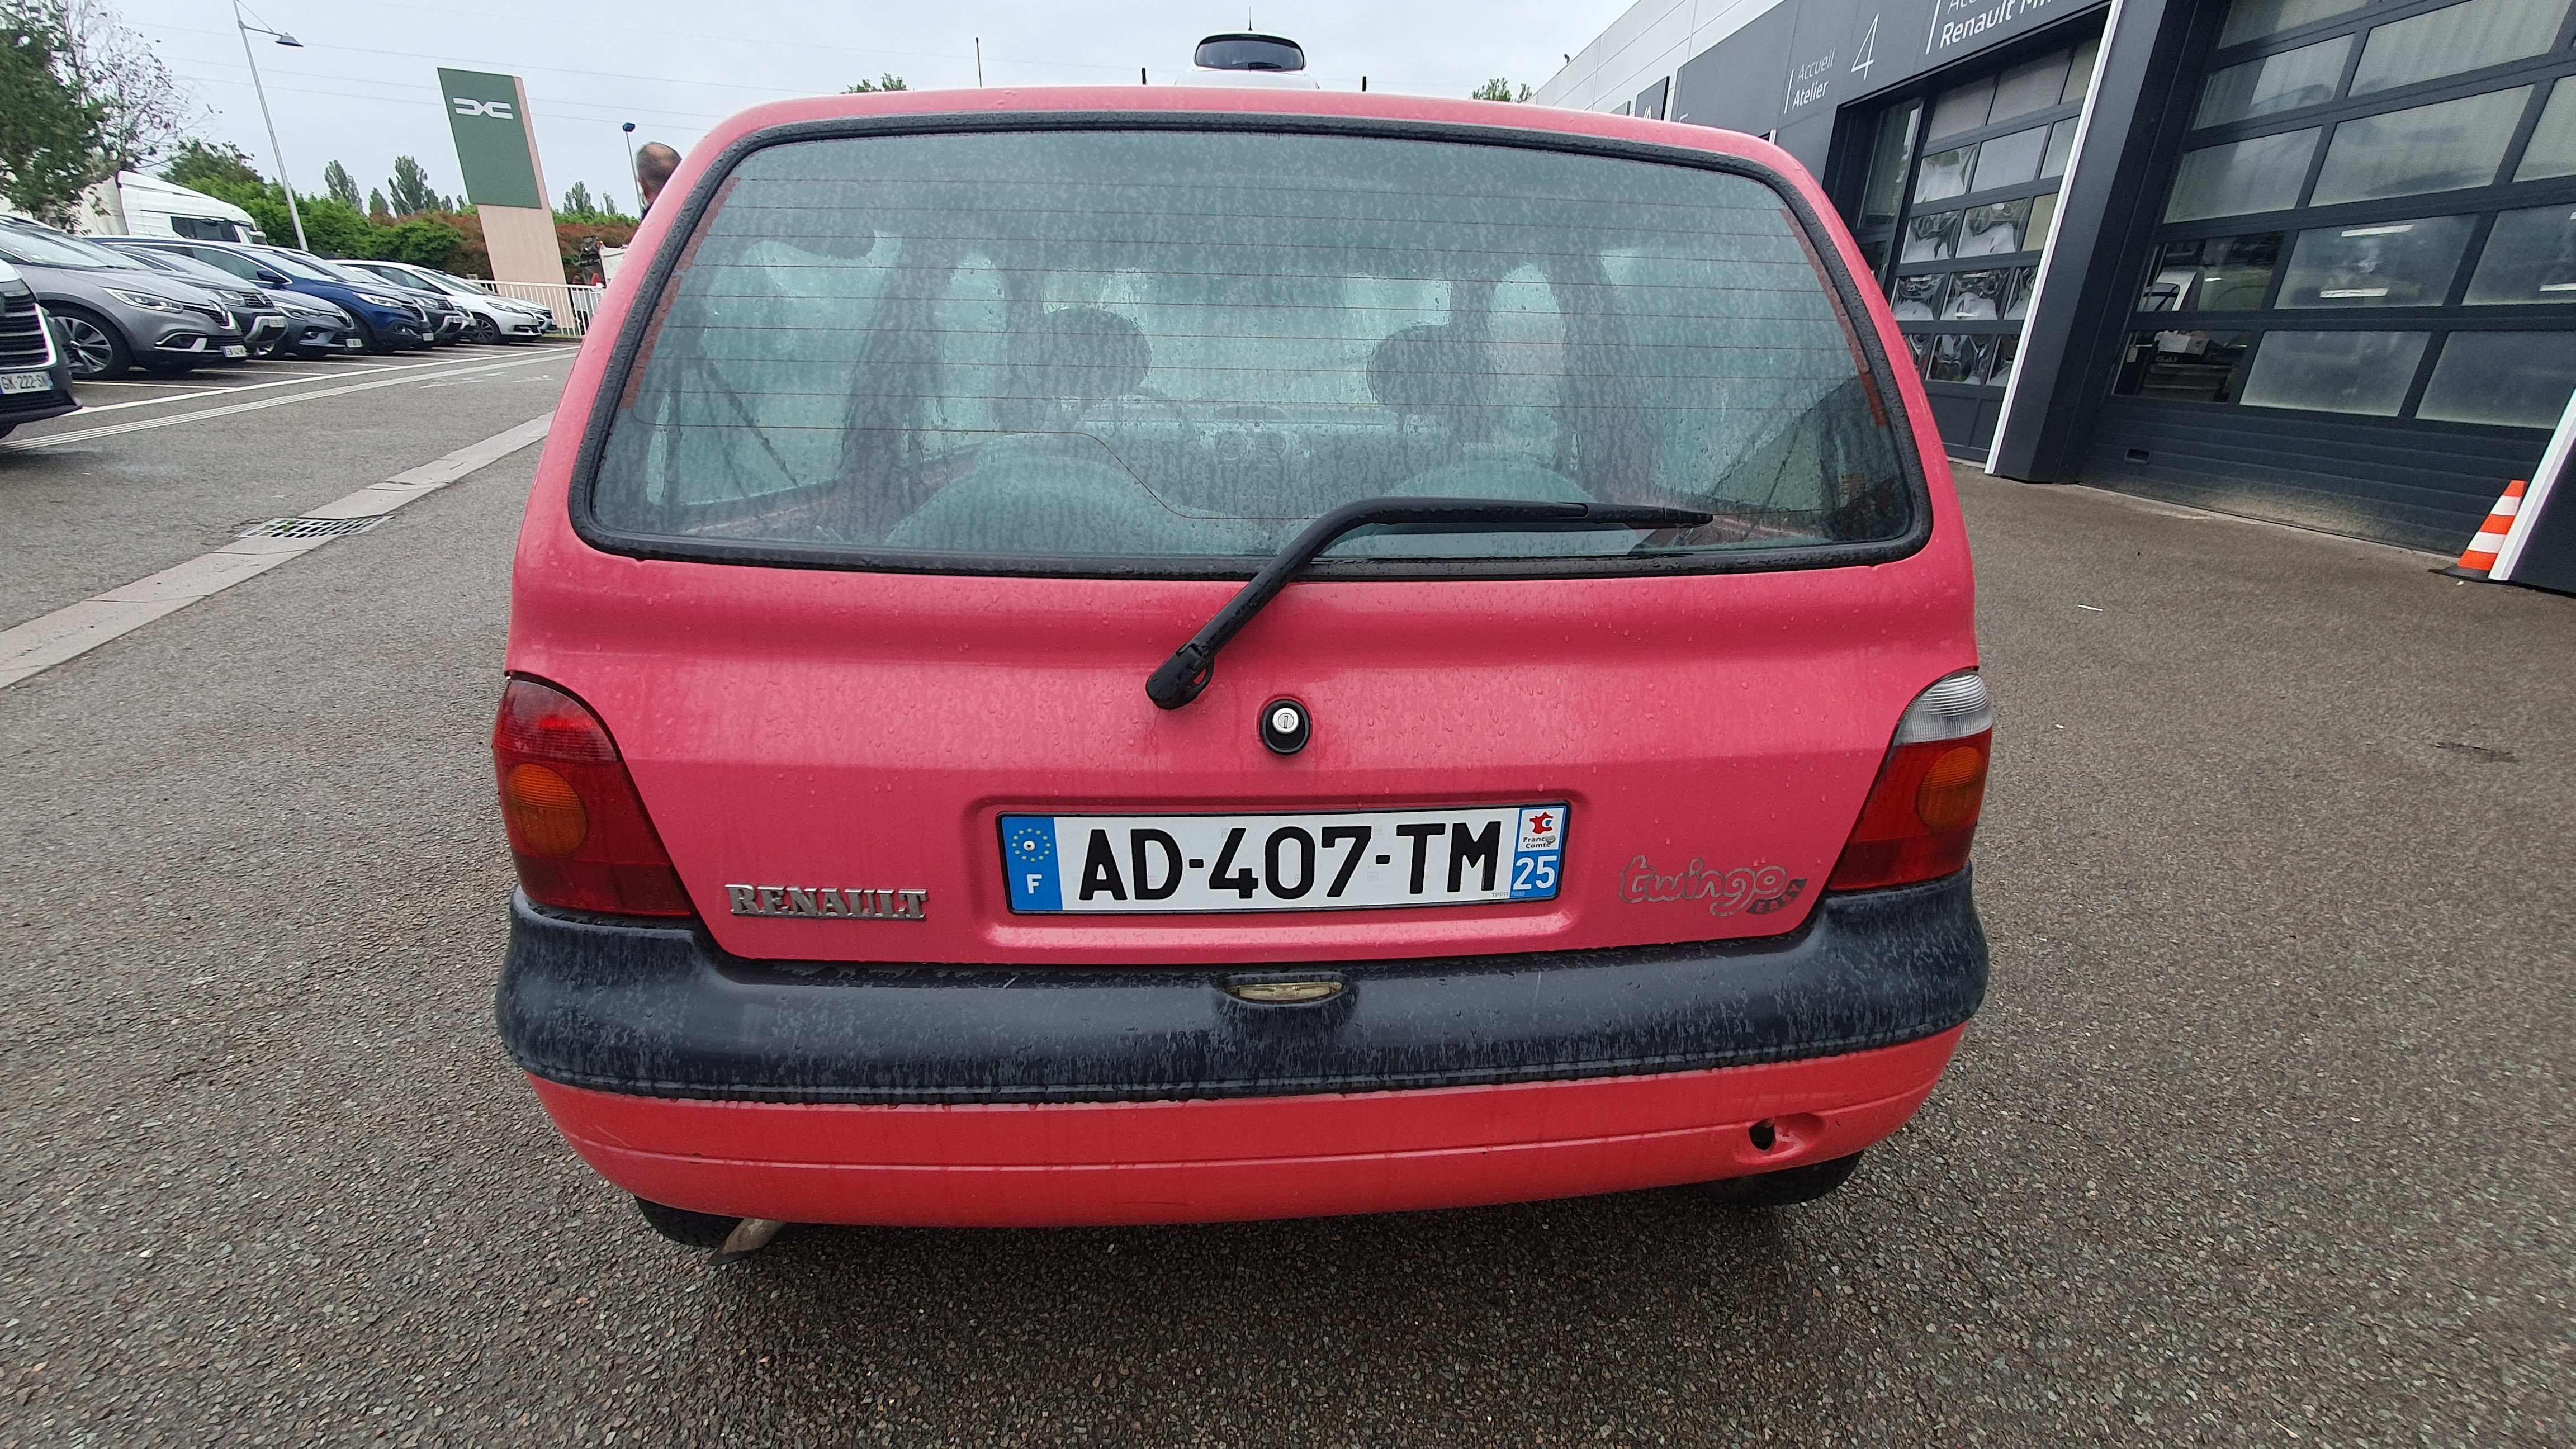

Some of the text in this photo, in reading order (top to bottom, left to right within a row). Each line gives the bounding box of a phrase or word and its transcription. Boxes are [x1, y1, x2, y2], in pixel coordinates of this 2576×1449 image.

[1939, 0, 2015, 49] Renault
[1797, 46, 1836, 83] Accueil
[1851, 13, 1879, 80] 4
[1792, 80, 1829, 110] Atelier
[1079, 821, 1502, 901] AD-407-TM
[1513, 855, 1557, 891] 25
[724, 884, 927, 921] RENAULT
[1026, 874, 1043, 894] F
